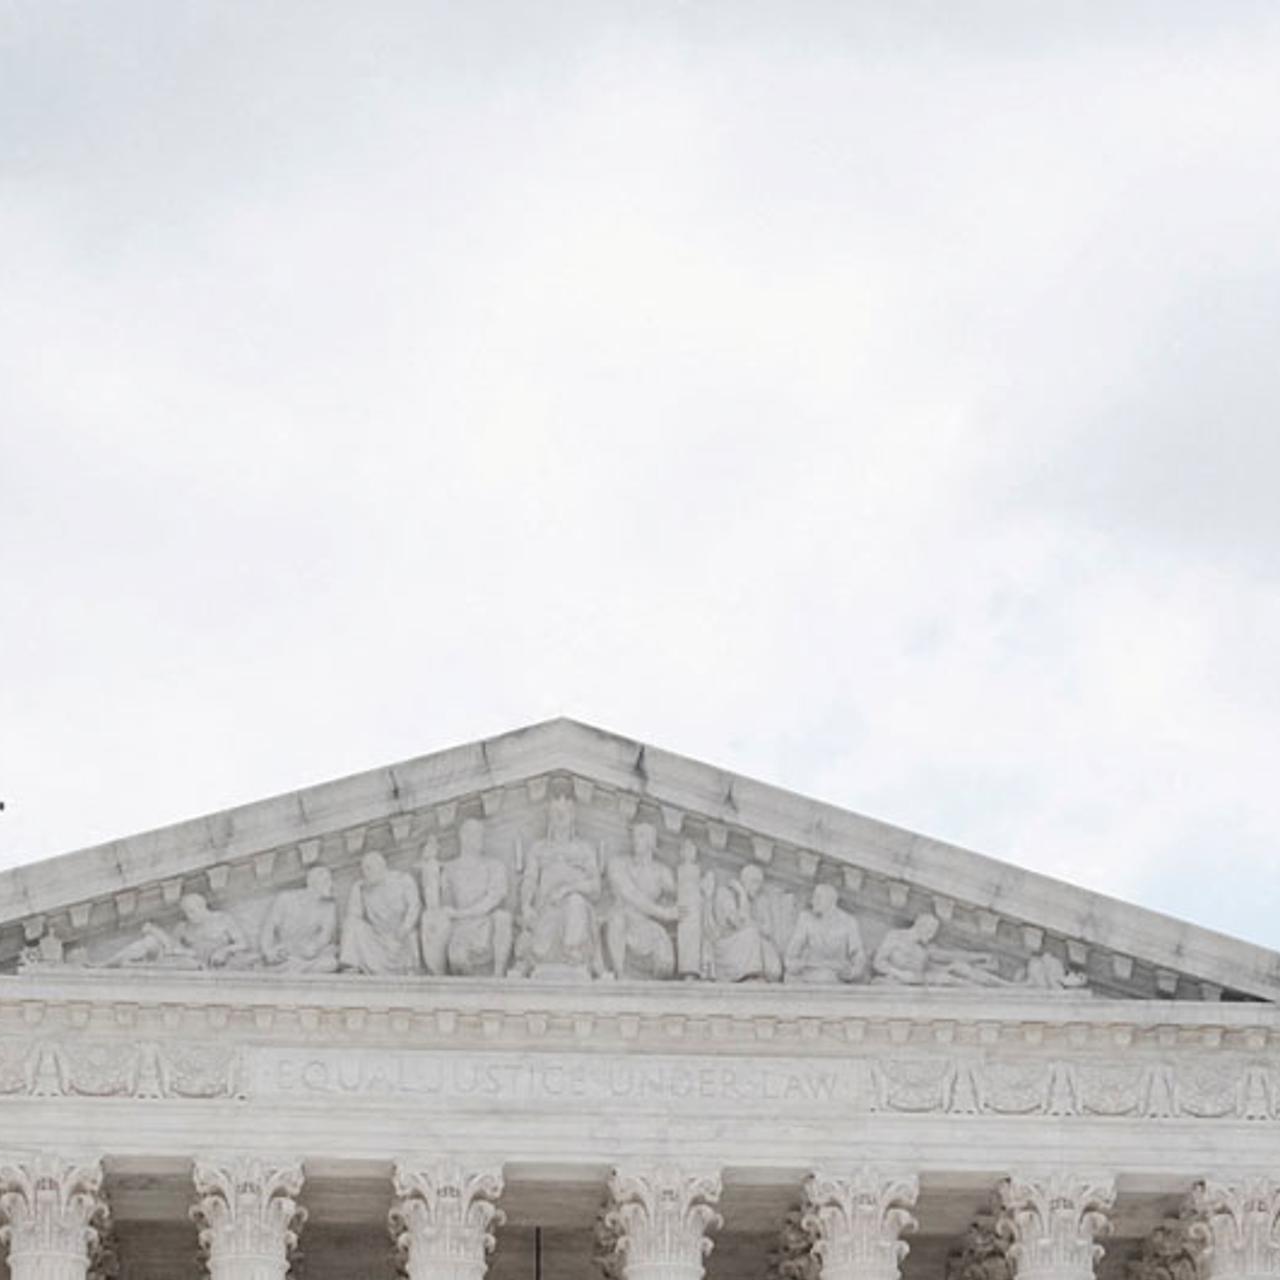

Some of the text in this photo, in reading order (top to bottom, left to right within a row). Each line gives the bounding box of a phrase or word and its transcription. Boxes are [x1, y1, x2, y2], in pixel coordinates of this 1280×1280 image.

[277, 1058, 839, 1100] EQUAL JUSTICE UNDER LAW
